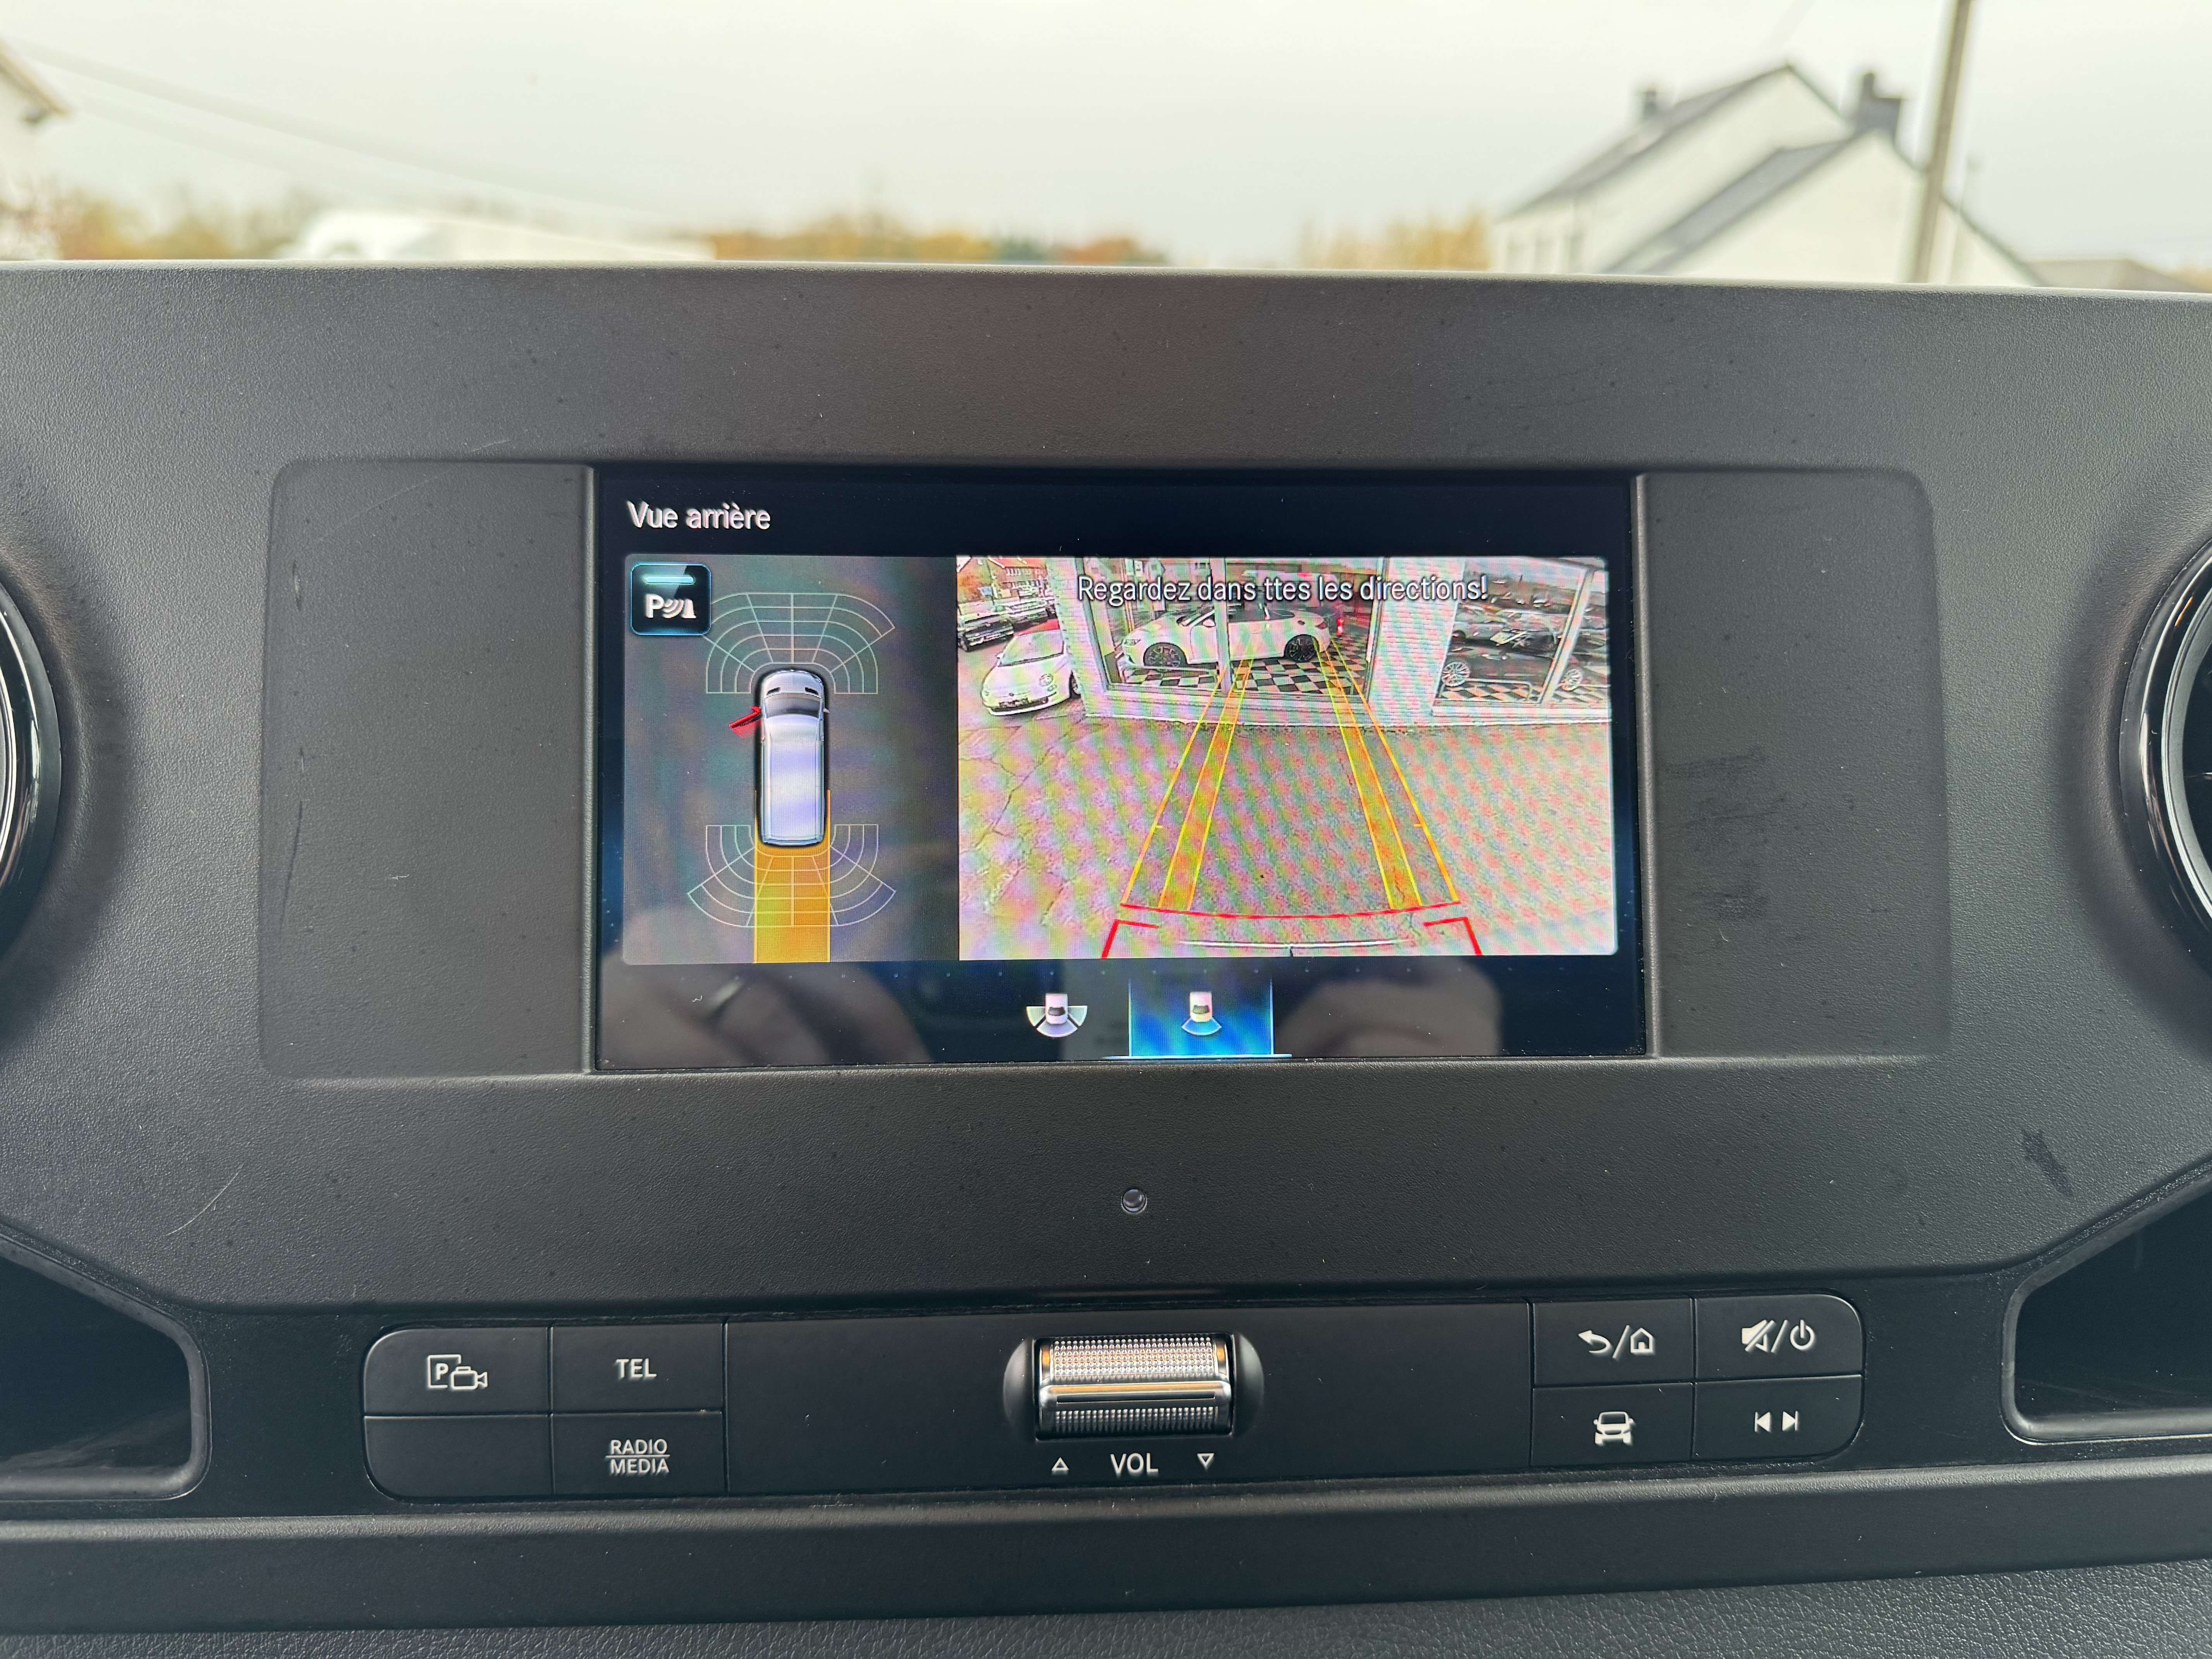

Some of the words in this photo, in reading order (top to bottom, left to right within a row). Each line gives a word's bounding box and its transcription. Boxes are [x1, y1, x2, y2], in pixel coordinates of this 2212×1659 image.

[627, 501, 678, 528] Vue
[686, 503, 771, 530] arrière
[1079, 576, 1192, 606] Regardez
[1197, 577, 1257, 600] dans
[1263, 578, 1310, 600] ttes
[1318, 575, 1353, 600] les
[1359, 575, 1488, 600] directions!
[645, 594, 663, 618] P
[616, 1358, 657, 1378] TEL
[610, 1439, 668, 1455] RADIO
[609, 1459, 670, 1475] MEDIA
[1110, 1453, 1159, 1474] VOL
